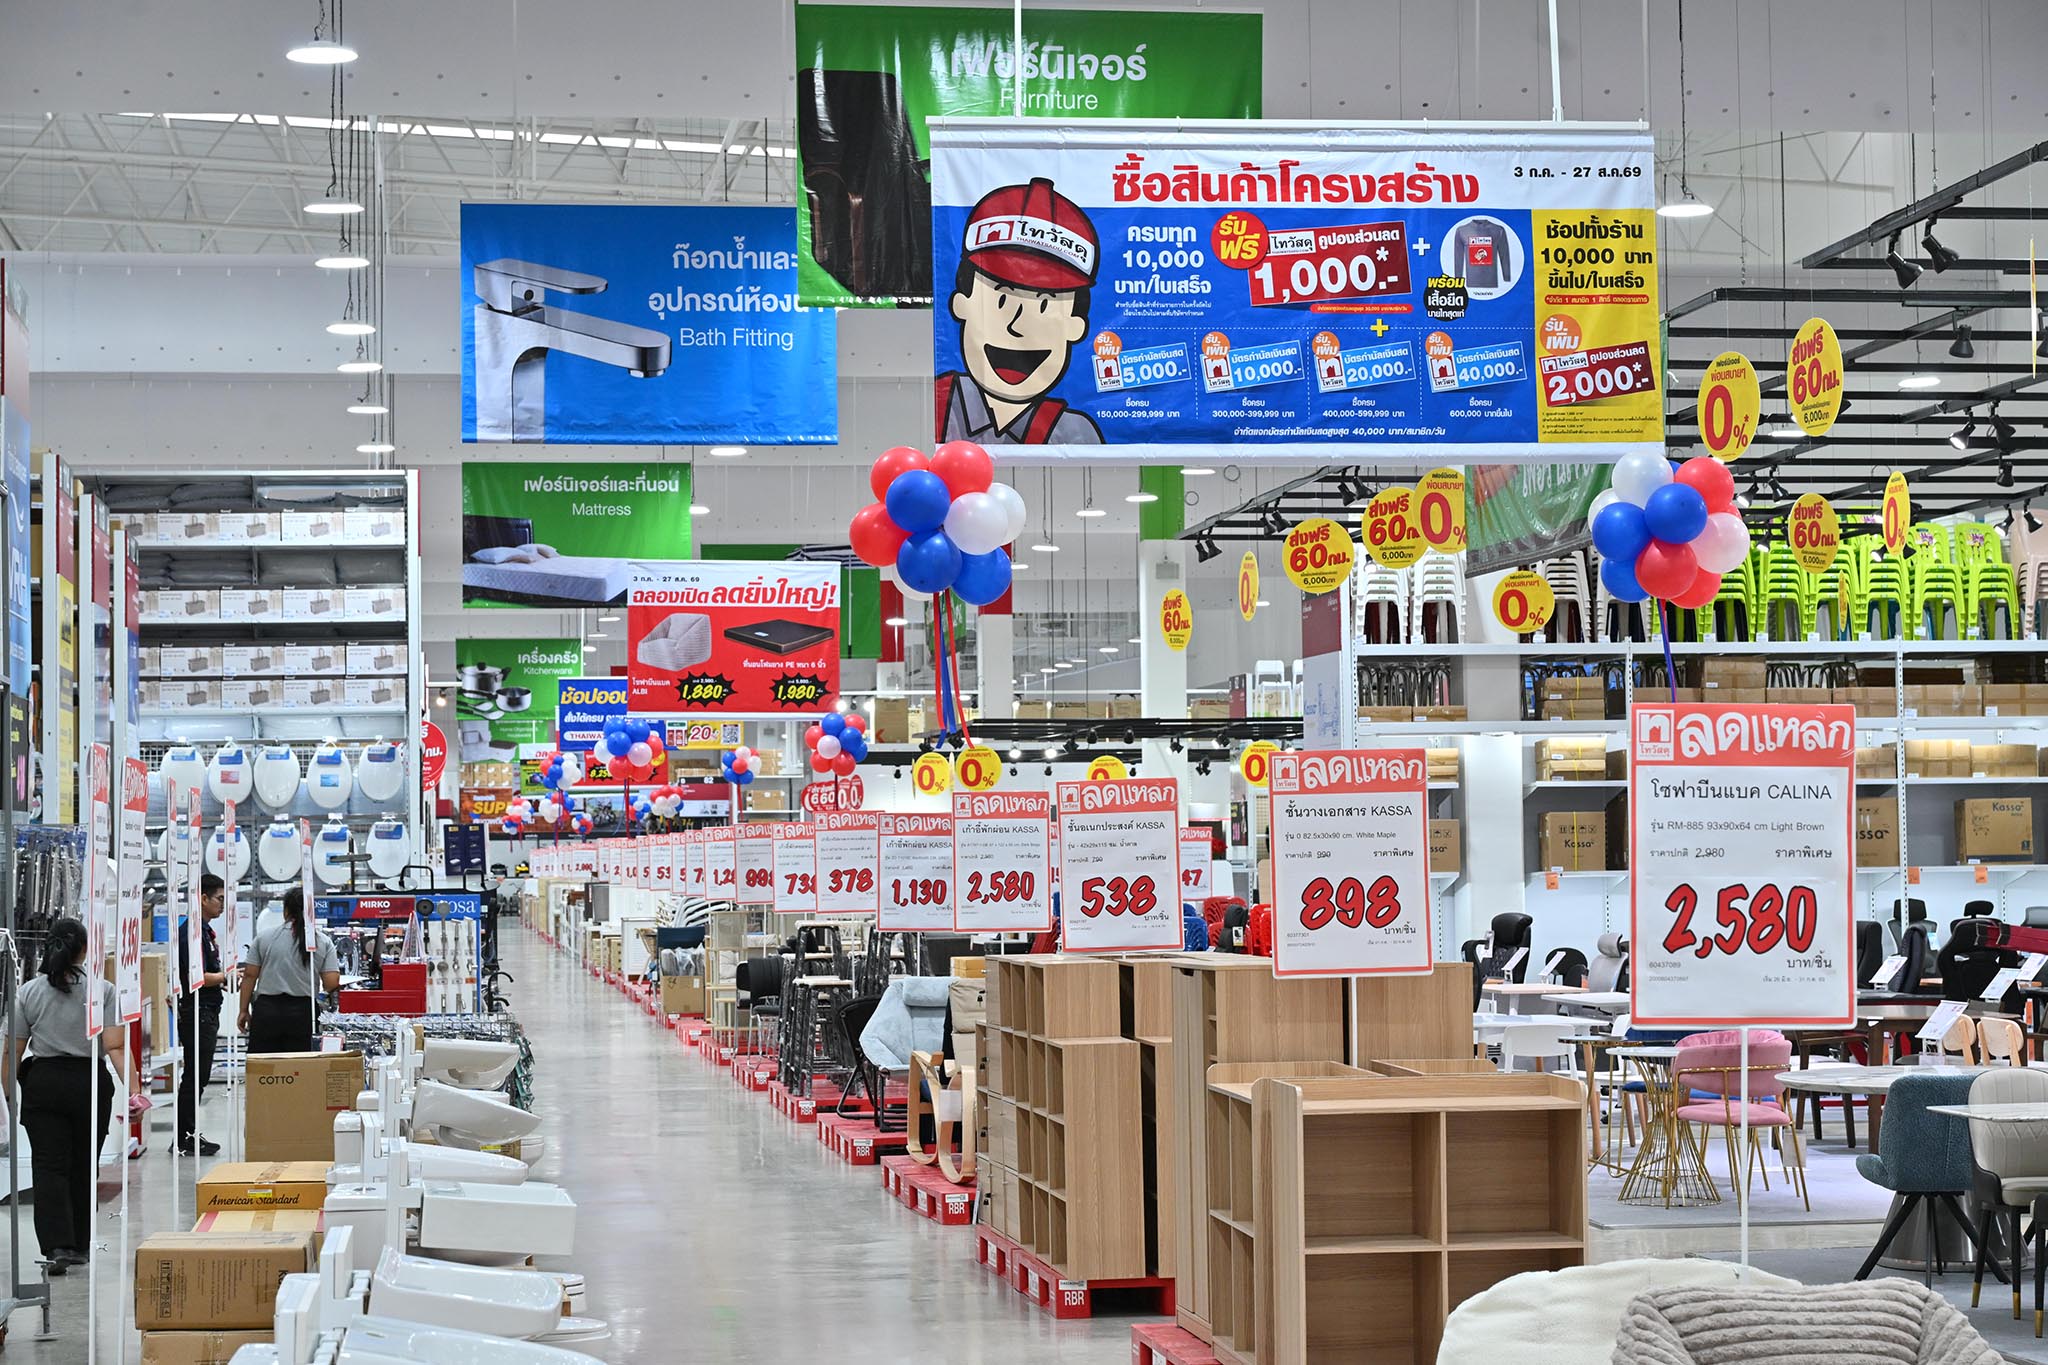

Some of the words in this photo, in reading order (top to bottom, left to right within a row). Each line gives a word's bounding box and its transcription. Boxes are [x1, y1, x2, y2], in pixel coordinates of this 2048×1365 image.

[951, 43, 1147, 81] เฟอร์นิเจอร์
[1112, 152, 1480, 203] ซื้อสินค้าโครงสร้าง
[1529, 168, 1555, 178] ก.ค.
[1573, 167, 1591, 178] 27
[1598, 166, 1642, 178] ส.ค.69
[1219, 215, 1247, 236] รับ
[1546, 215, 1643, 239] ช้อปทั้งร้าน
[1017, 220, 1089, 263] ไทวัสดุ
[1127, 223, 1197, 249] ครบทุก
[1271, 235, 1313, 251] ไทวัสดุ
[1319, 229, 1400, 249] คูปองส่วนลด
[672, 236, 798, 270] ก๊อกน้ำและ
[1220, 232, 1261, 261] ฟรี
[1122, 250, 1204, 272] 10,000
[1541, 247, 1615, 267] 10,000
[1625, 252, 1653, 264] บาท
[1114, 274, 1212, 295] บาท/ใบเสร็จ
[1428, 274, 1465, 288] พร้อม
[1548, 271, 1645, 289] ขึ้นไป/ใบเสร็จ
[649, 285, 824, 321] อุปกรณ์ห้องน
[1428, 290, 1464, 306] เสื้อยืด
[1545, 317, 1568, 332] รับ
[680, 328, 726, 347] Bath
[733, 328, 794, 352] Fitting
[1546, 328, 1580, 349] เพิ่ม
[1792, 326, 1823, 365] ส่งฟรี
[1121, 349, 1184, 365] บัตรกำนัลเงินสด
[1231, 347, 1297, 364] บัตรกำนัลเงินสด
[1344, 348, 1409, 364] บัตรกำนัลเงินสด
[1456, 348, 1520, 364] บัตรกำนัลเงินสด
[1557, 357, 1587, 369] ไทวัสดุ
[1590, 346, 1645, 365] คูปองส่วนลด
[1123, 360, 1187, 385] 5,000.-
[1234, 360, 1302, 382] 10,000.-
[1346, 360, 1412, 382] 20,000.-
[1459, 361, 1523, 382] 40,000.-
[1125, 397, 1150, 407] ซื้อครบ
[1242, 397, 1265, 407] ซื้อครบ
[1352, 397, 1376, 406] ซื้อครบ
[1469, 397, 1493, 406] ซื้อครบ
[1212, 410, 1279, 418] 300,000-399,999
[1323, 410, 1390, 418] 400,000-599,999
[1450, 410, 1482, 418] 600,000
[1484, 409, 1513, 417] บาทขึ้นไป
[1352, 427, 1385, 437] 40,000
[1388, 426, 1446, 437] บาท/สมาชิก/วัน
[524, 471, 679, 493] เฟอร์นิเจอร์และที่นอน
[572, 502, 632, 517] Mattress
[1369, 493, 1409, 518] ส่งฟรี
[1794, 501, 1823, 520] ส่งฟรี
[1289, 523, 1330, 548] ส่งฟรี
[632, 587, 710, 603] ฉลองเปิด
[711, 576, 837, 610] ลดยิ่งใหญ่!
[518, 647, 579, 664] เครื่องครัว
[524, 667, 574, 675] Kitchenware
[1640, 744, 1670, 757] ไทวัสดุ
[1676, 709, 1851, 758] ลดแหลก
[1300, 755, 1423, 789] ลดแหลก
[1082, 784, 1176, 810] ลดแหลก
[1650, 778, 1761, 799] โซฟาบีนแบค
[1767, 784, 1833, 800] CALINA
[473, 801, 512, 815] SUP
[973, 795, 1048, 815] ลดแหลก
[1285, 800, 1366, 818] ชั้นวางเอกสาร
[1371, 805, 1413, 816] KASSA
[1992, 802, 2023, 812] Kassa
[962, 821, 1010, 833] เก้าอี้พักผ่อน
[1067, 819, 1134, 832] ชั้นอเนกประสงค์
[1136, 822, 1165, 830] KASSA
[1650, 820, 1664, 832] รุ่น
[1667, 821, 1704, 831] RM-885
[1707, 821, 1752, 831] 93x90x64
[1754, 823, 1768, 831] cm
[1771, 821, 1793, 832] Light
[1796, 822, 1825, 831] Brown
[1356, 831, 1375, 839] White
[1376, 831, 1397, 840] Maple
[1564, 839, 1595, 848] Kassa
[929, 841, 952, 849] KASSA
[1373, 848, 1414, 857] ราคาพิเศษ
[1650, 847, 1689, 858] ราคาปกติ
[1695, 848, 1725, 858] 2,980
[1775, 845, 1833, 860] ราคาพิเศษ
[828, 868, 874, 893] 378
[966, 870, 1035, 904] 2,580
[891, 879, 947, 907] 1,130
[1080, 875, 1157, 918] 538
[1300, 875, 1401, 931] 898
[1384, 922, 1416, 935] บาท/ชิ้น
[1662, 883, 1817, 959] 2,580
[1786, 951, 1832, 969] บาท/ชิ้น
[259, 1075, 294, 1085] COTTO
[856, 1146, 870, 1157] RBR
[208, 1195, 253, 1206] American
[256, 1194, 300, 1205] Standard
[949, 1202, 965, 1215] RBR
[1064, 1291, 1084, 1306] RBR
